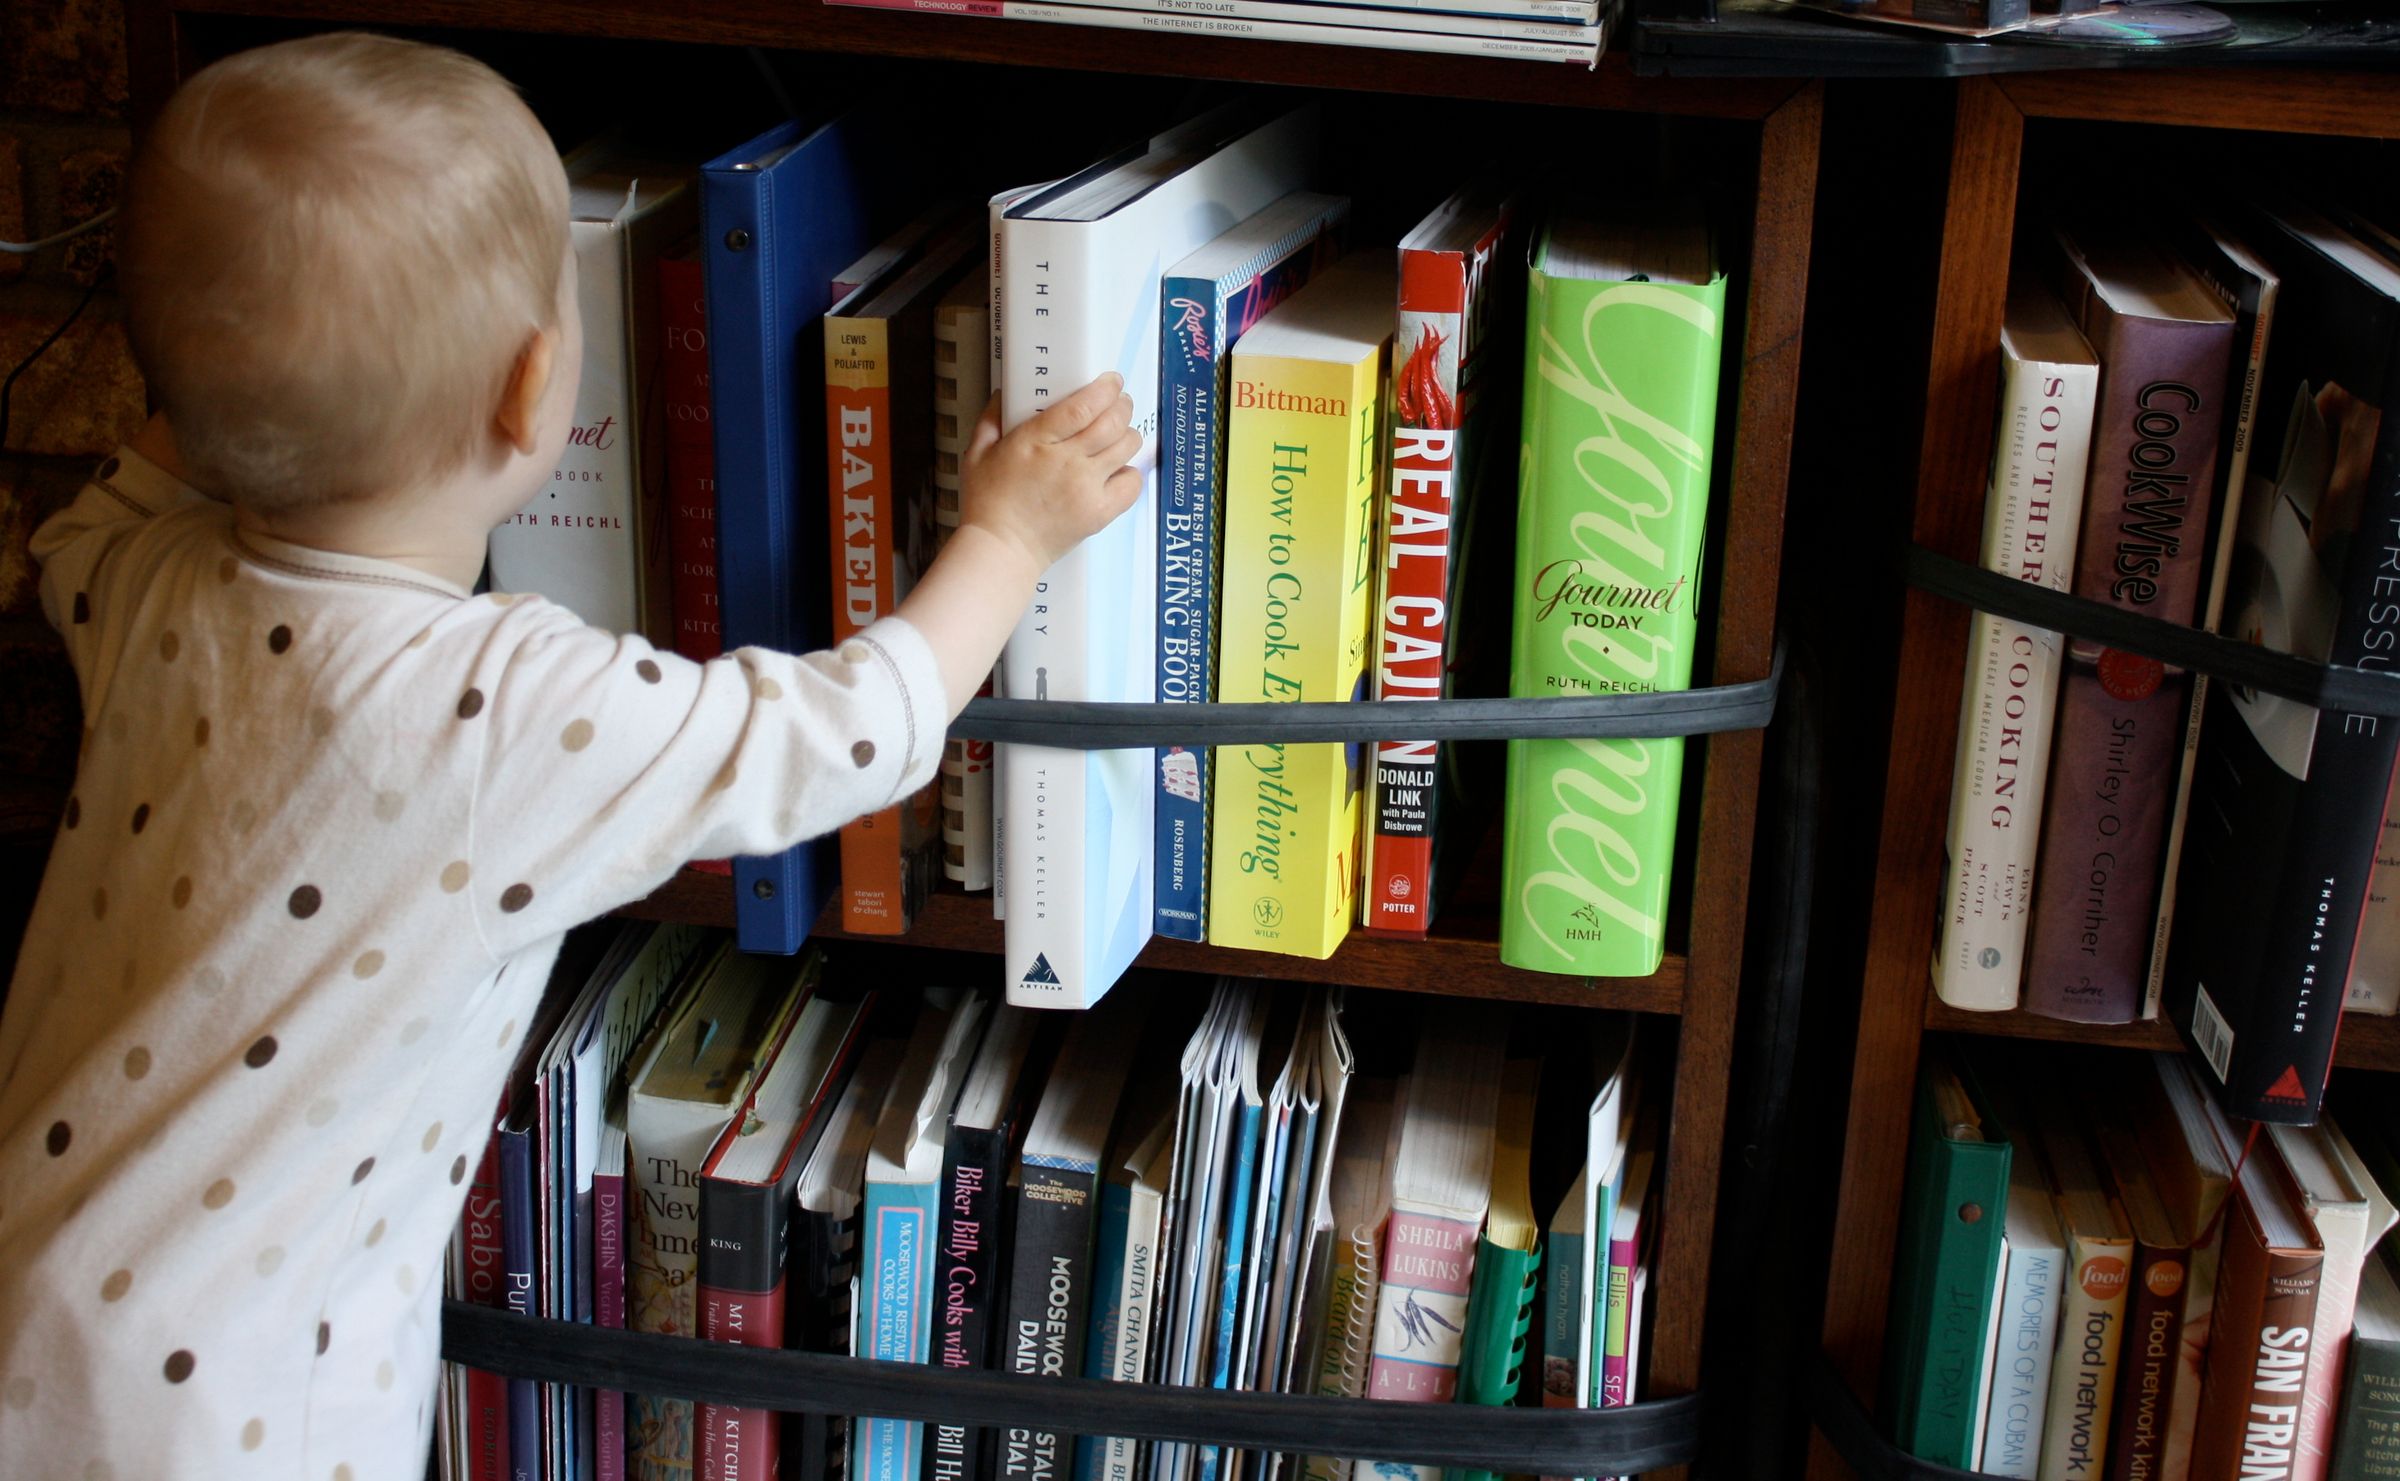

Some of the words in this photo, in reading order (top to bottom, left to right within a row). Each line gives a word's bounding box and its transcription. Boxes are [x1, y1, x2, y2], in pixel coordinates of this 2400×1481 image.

[914, 0, 967, 11] TECHNOLOGY
[968, 3, 997, 13] REVIEW
[1142, 16, 1159, 26] THE
[1161, 18, 1202, 30] INTERNET
[1205, 21, 1214, 30] IS
[1216, 22, 1253, 33] BROKEN
[1157, 0, 1173, 8] IT'S
[1174, 1, 1198, 10] NOT
[1199, 2, 1213, 11] TOO
[1215, 3, 1235, 13] LATE
[994, 287, 1002, 331] OCTOBER
[1036, 261, 1049, 317] THE
[667, 327, 706, 352] FO
[841, 334, 867, 345] LEWIS
[851, 348, 857, 356] &
[994, 335, 1003, 360] 2009
[1178, 331, 1197, 374] BAKERY
[2251, 313, 2266, 362] GOURMET
[834, 358, 875, 371] POLIAFITO
[1035, 346, 1048, 396] FRE
[1235, 381, 1347, 417] Bittman
[2240, 368, 2257, 424] NOVEMBER
[1174, 383, 1188, 508] NO-HOLDS-BARRED
[1192, 387, 1208, 488] ALL-BUTTER,
[2012, 405, 2029, 458] RECIPES
[2236, 427, 2247, 453] 2009
[555, 470, 604, 482] BOOK
[1270, 441, 1308, 527] How
[2008, 465, 2020, 488] AND
[2020, 377, 2065, 585] SOUTHER
[2113, 381, 2202, 602] CookWise
[840, 404, 877, 628] BAKED
[1192, 493, 1205, 543] FRESH
[1389, 426, 1454, 570] REAL
[504, 513, 538, 526] TH
[551, 514, 622, 530] REICHL
[1163, 511, 1191, 627] BAKING
[1268, 533, 1297, 566] to
[1190, 549, 1203, 604] CREAM,
[1531, 558, 1688, 623] Gourmet
[1264, 572, 1303, 662] Cook
[1570, 612, 1644, 631] TODAY
[1991, 621, 2003, 645] TWO
[1162, 635, 1189, 703] BOO
[1188, 608, 1202, 703] SUGAR-PACK
[1985, 651, 1999, 688] GREAT
[1378, 595, 1445, 765] CAJN
[1545, 675, 1592, 692] RUTH
[1599, 677, 1661, 694] REICHL
[1978, 692, 1997, 754] AMERICAN
[1990, 634, 2034, 831] COOKING
[1239, 667, 1303, 884] Erything
[1378, 767, 1435, 787] DONALD
[1972, 759, 1986, 797] COOKS
[2095, 717, 2137, 810] Shirley
[1036, 768, 1046, 842] THOMAS
[1382, 807, 1400, 818] with
[1401, 808, 1426, 820] Paula
[1389, 788, 1422, 806] LINK
[1383, 820, 1423, 832] Disbrowe
[2095, 814, 2122, 842] O.
[1173, 819, 1185, 891] ROSENBERG
[1036, 855, 1046, 920] KELLER
[1382, 902, 1416, 914] POTTER
[1955, 847, 1974, 927] PEACOCK
[1974, 863, 1989, 917] SCOTT
[2001, 863, 2016, 921] LEWIS
[2017, 867, 2032, 915] EDNA
[2080, 851, 2116, 958] Corriher
[863, 906, 888, 918] chang
[1160, 908, 1197, 920] WORKMAN
[2310, 877, 2335, 952] THOMAS
[1254, 928, 1281, 940] WILEY
[1565, 928, 1603, 942] HMH
[1019, 983, 1064, 992] ARTISAN
[2292, 964, 2316, 1033] KELLER
[954, 1164, 984, 1216] Biker
[1024, 1183, 1087, 1199] MOOSEWOOD
[1026, 1191, 1084, 1206] COLLECTIVE
[469, 1194, 503, 1305] Sabo
[600, 1193, 617, 1270] DAKSHIN
[710, 1238, 742, 1251] KING
[944, 1219, 980, 1262] Billy
[1397, 1223, 1464, 1253] SHEILA
[883, 1258, 896, 1301] COOKS
[896, 1221, 912, 1308] MOOSEWOOD
[1128, 1243, 1149, 1300] SMITA
[1393, 1254, 1461, 1283] LUKINS
[1560, 1264, 1570, 1306] nathan
[2080, 1263, 2127, 1287] food
[2146, 1265, 2184, 1287] food
[2272, 1276, 2315, 1287] WILLIAMS
[508, 1272, 531, 1315] Pur
[884, 1301, 892, 1313] AT
[945, 1265, 977, 1327] Cooks
[1324, 1275, 1356, 1344] Beard
[1609, 1271, 1627, 1309] Ellis
[2015, 1255, 2049, 1354] MEMORIES
[2273, 1286, 2311, 1297] SONOMA
[728, 1303, 743, 1332] MY
[879, 1315, 893, 1356] HOME
[893, 1310, 909, 1361] RESTAU
[1041, 1254, 1072, 1377] MOOSEWO
[2143, 1309, 2174, 1358] food
[942, 1330, 970, 1368] with
[1121, 1305, 1142, 1383] CHAND
[2082, 1310, 2113, 1367] food
[2254, 1325, 2310, 1393] SAN
[1325, 1347, 1343, 1376] on
[2013, 1357, 2036, 1386] OF
[2010, 1385, 2032, 1399] A
[2134, 1356, 2162, 1449] network
[705, 1428, 716, 1452] Home
[2002, 1402, 2031, 1469] CUBAN
[2067, 1364, 2101, 1473] network
[2367, 1418, 2389, 1432] The
[601, 1429, 613, 1470] SOUTH
[724, 1419, 740, 1481] KITCH
[880, 1440, 893, 1481] MOOSE
[936, 1424, 965, 1457] Bill
[2239, 1404, 2298, 1481] FRAN
[2365, 1447, 2400, 1462] Kitche
[2371, 1435, 2385, 1447] of
